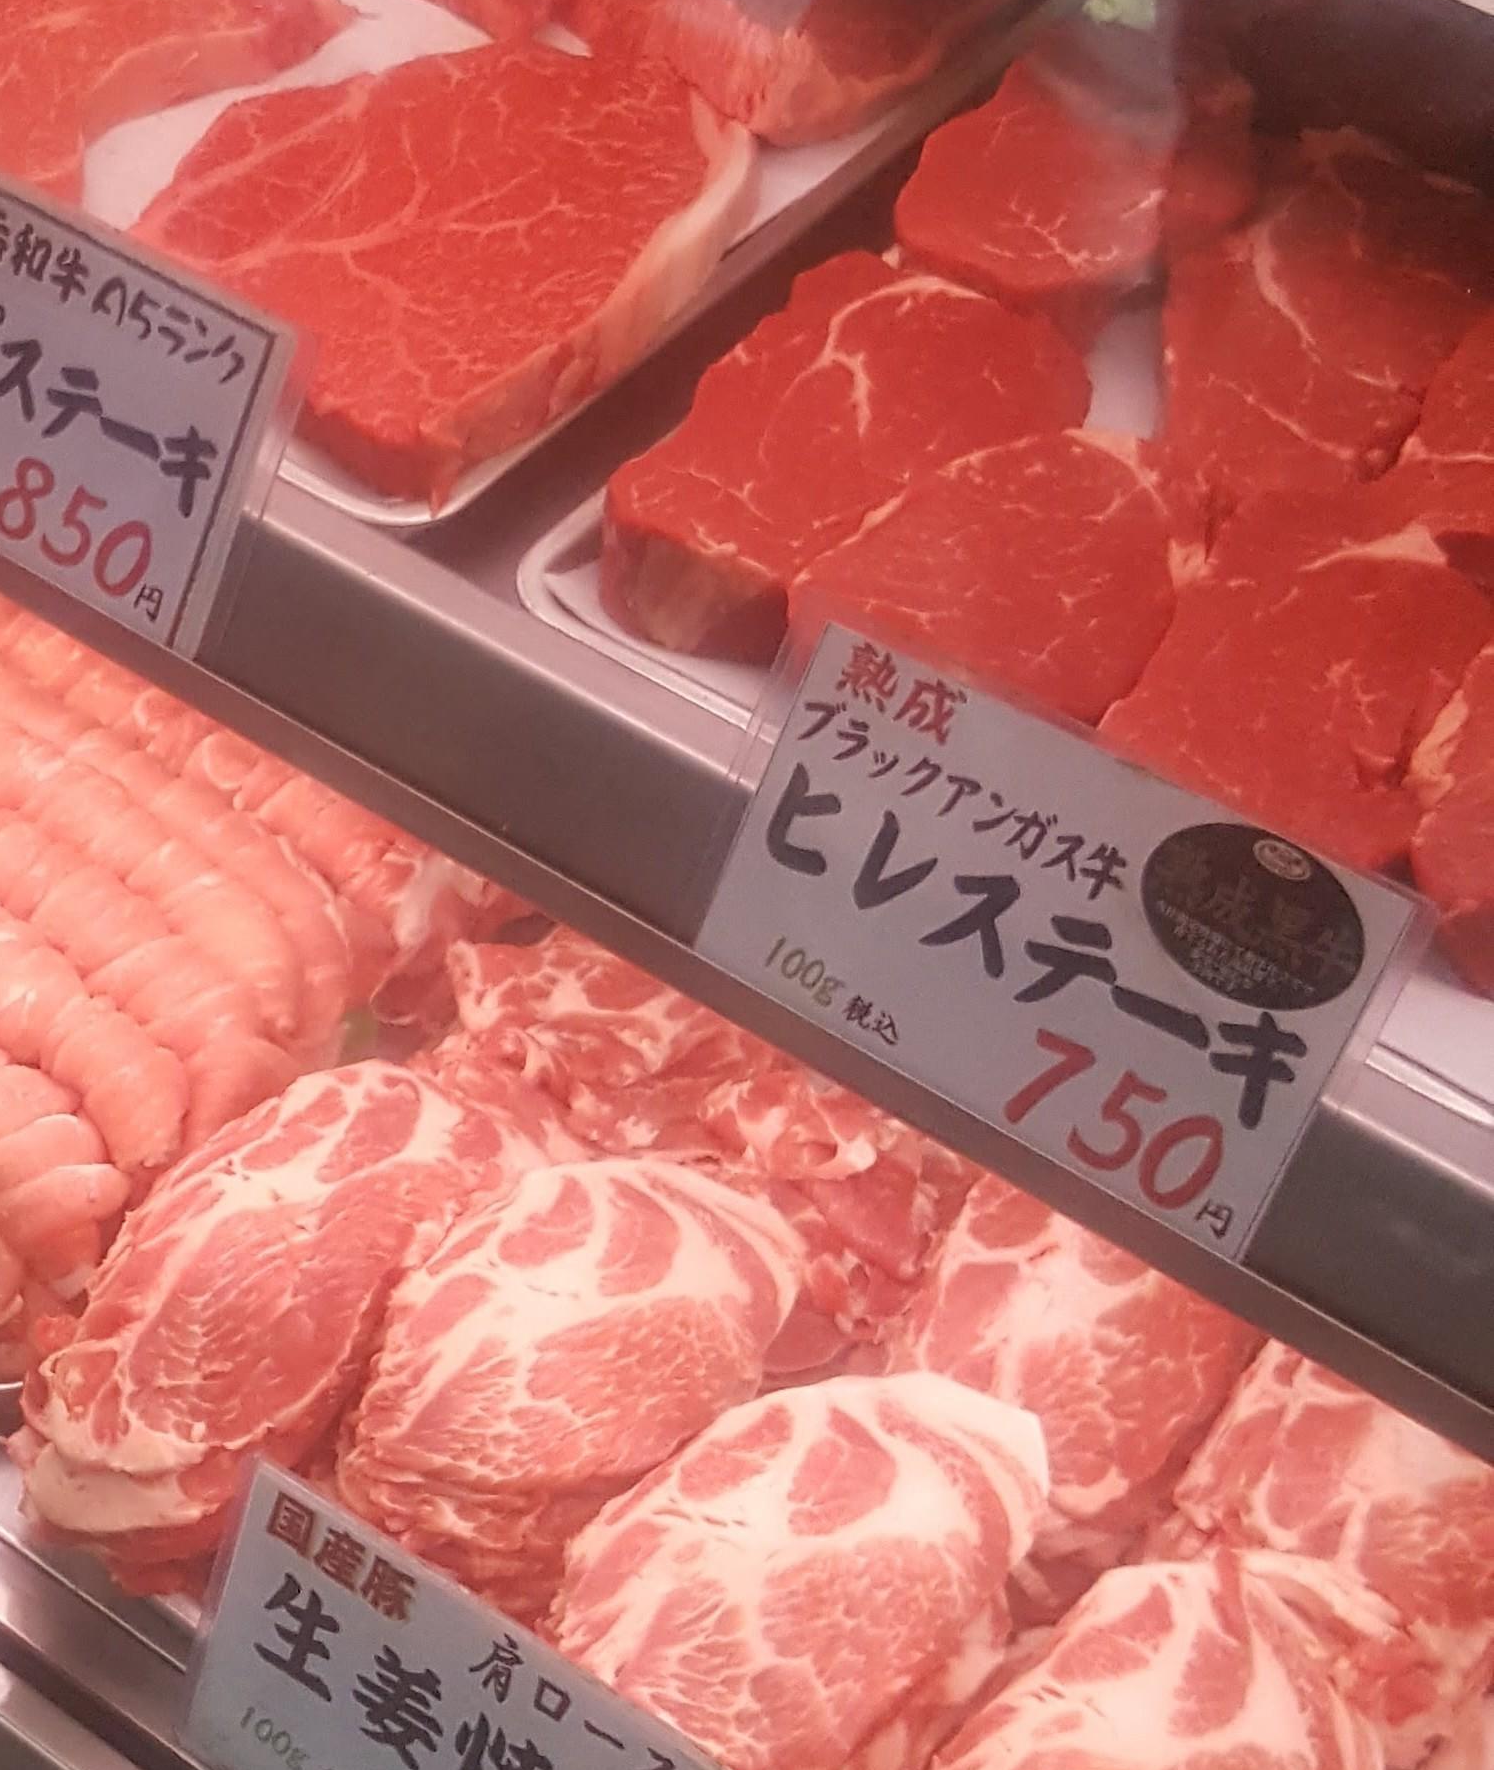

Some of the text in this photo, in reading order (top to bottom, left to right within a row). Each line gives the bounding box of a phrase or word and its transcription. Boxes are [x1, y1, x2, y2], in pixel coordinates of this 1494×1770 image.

[834, 641, 969, 745] 熟成
[796, 699, 1130, 902] ブラックアンガス牛
[763, 935, 902, 1047] 100g 税込
[765, 761, 1308, 1131] ヒレステーキ
[265, 1491, 418, 1623] 国産豚
